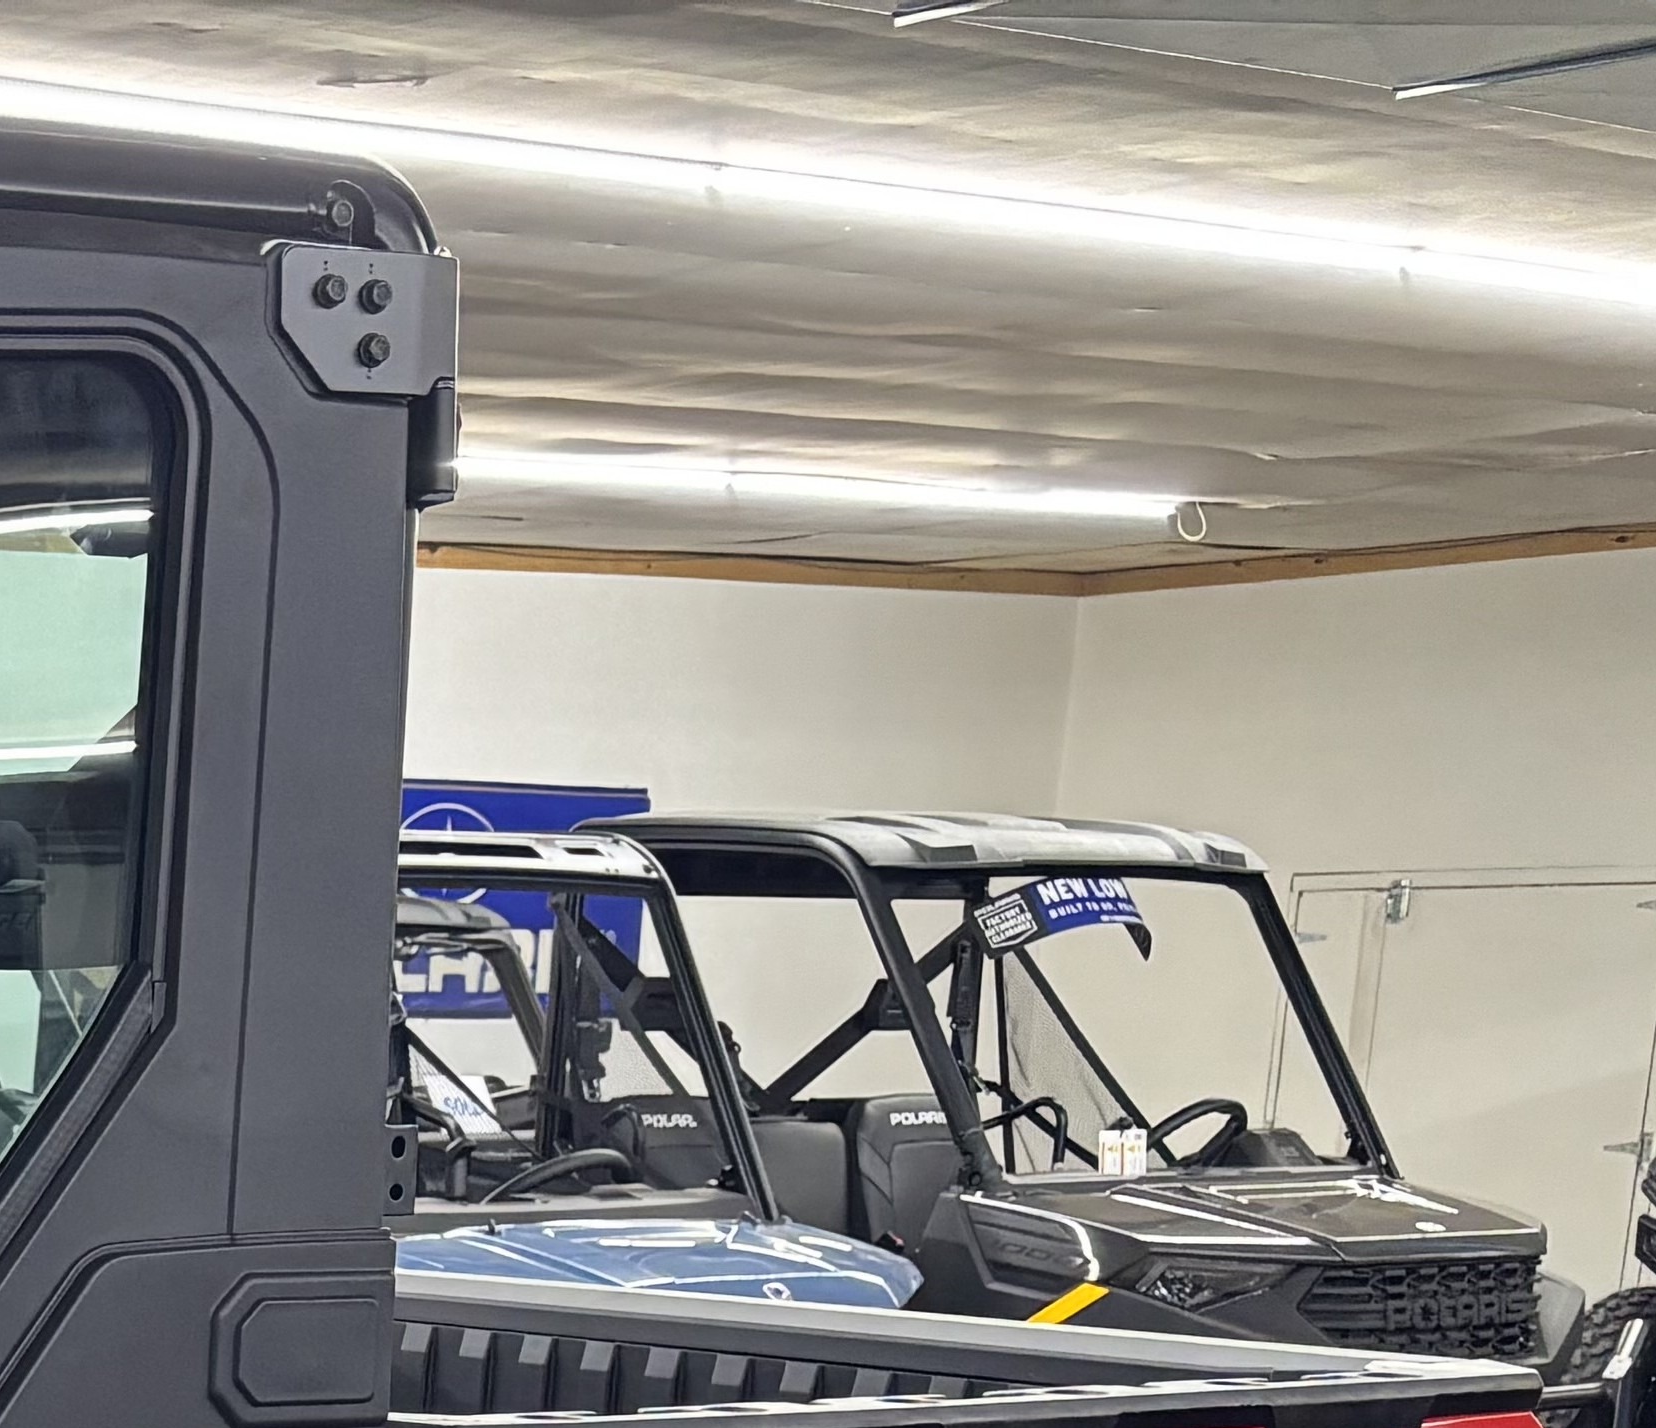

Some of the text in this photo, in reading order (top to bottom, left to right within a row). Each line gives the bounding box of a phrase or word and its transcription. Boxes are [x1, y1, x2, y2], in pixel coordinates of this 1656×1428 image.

[1037, 878, 1128, 905] NEW LOW
[1048, 902, 1084, 919] BUILT
